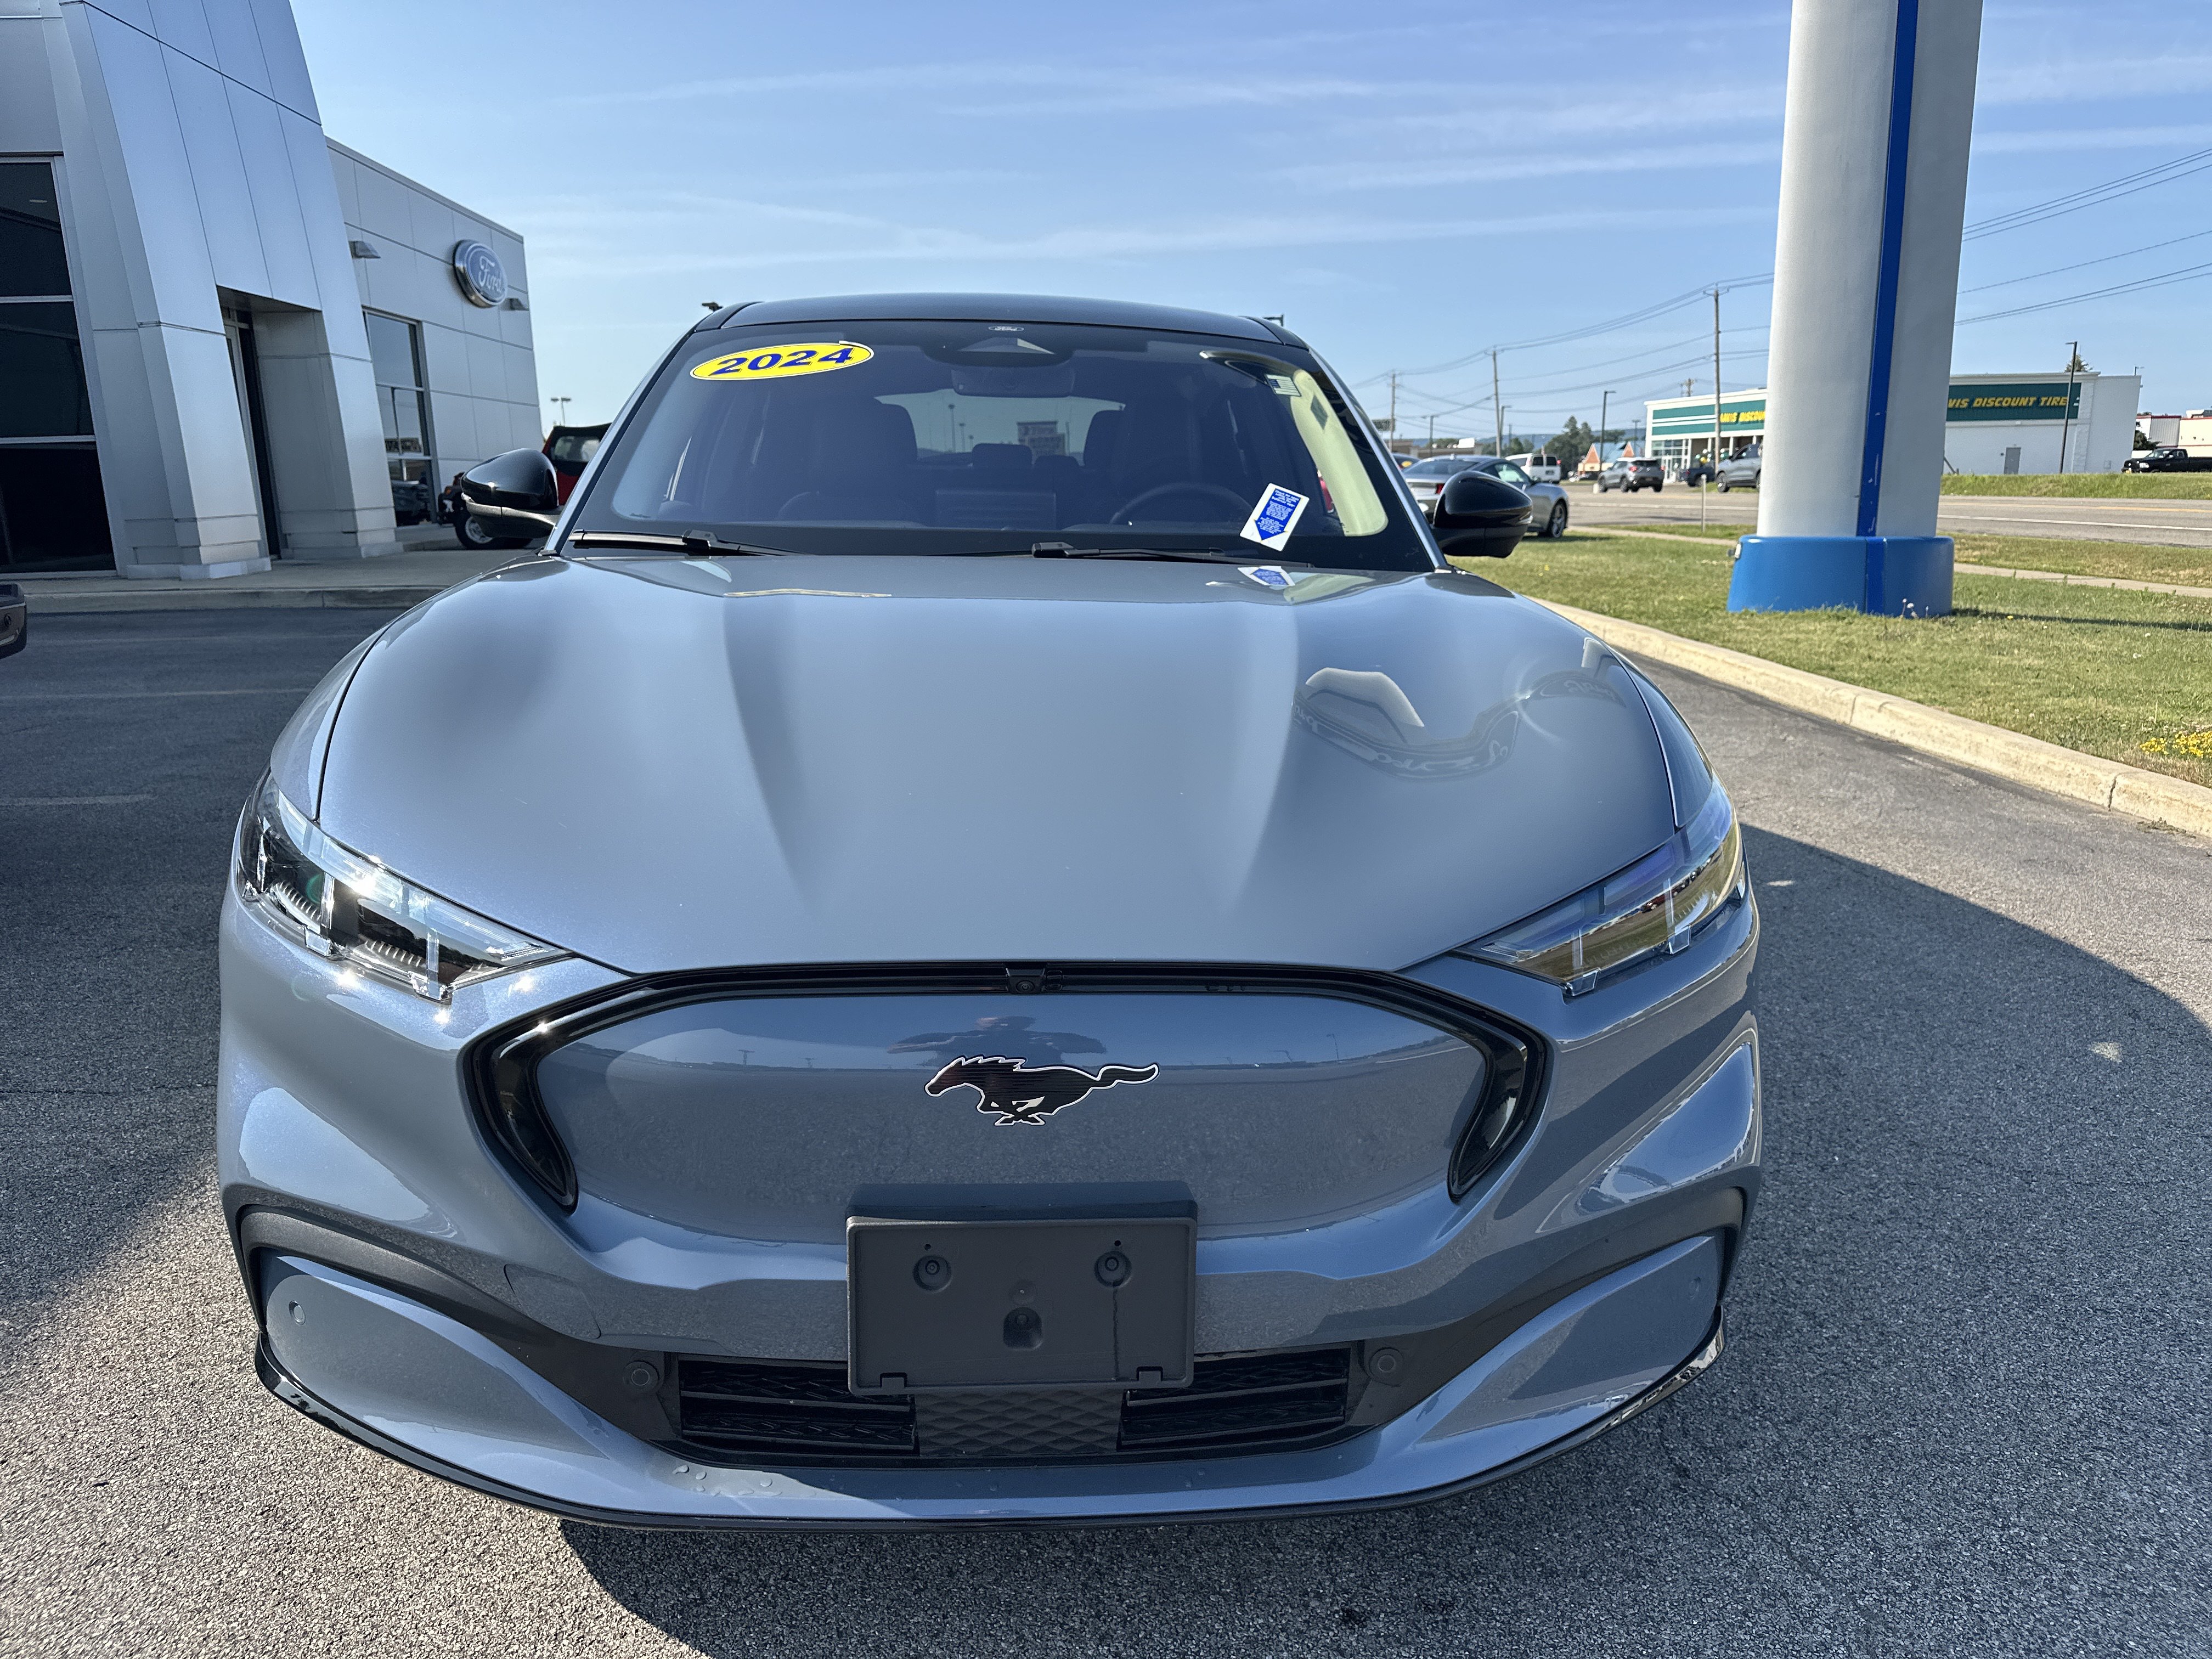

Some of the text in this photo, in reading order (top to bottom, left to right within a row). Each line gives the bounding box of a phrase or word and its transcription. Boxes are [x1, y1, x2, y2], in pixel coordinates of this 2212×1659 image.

[478, 256, 502, 294] Ford
[708, 347, 854, 376] 2024
[1948, 396, 2068, 408] VIS DISCOUNT TIRE
